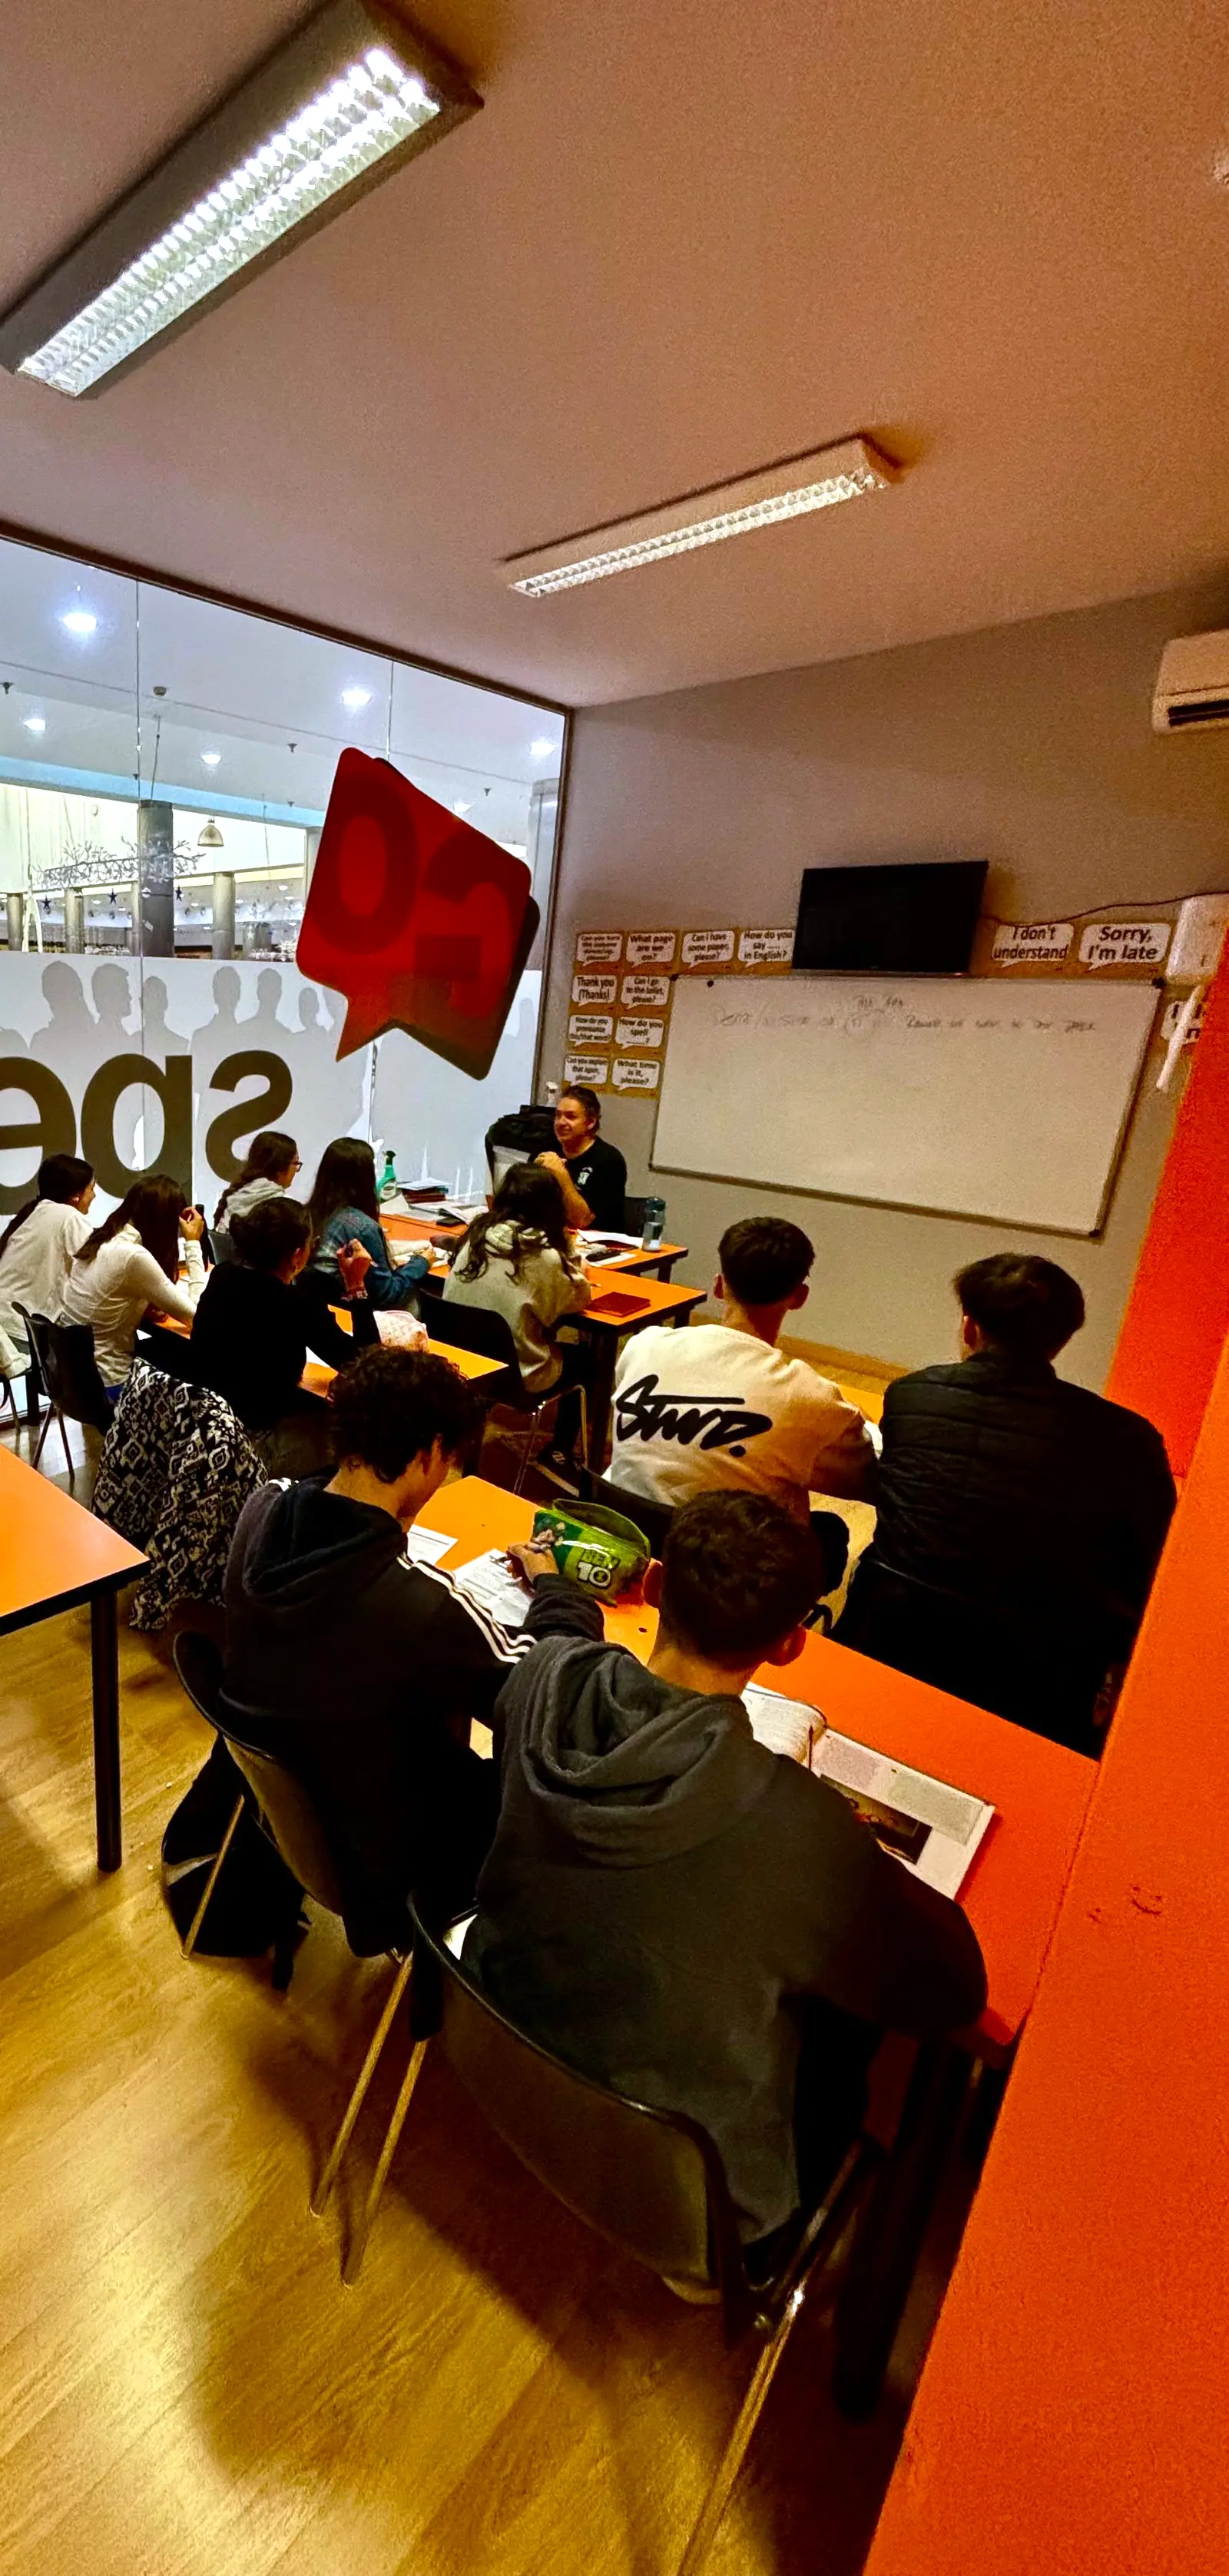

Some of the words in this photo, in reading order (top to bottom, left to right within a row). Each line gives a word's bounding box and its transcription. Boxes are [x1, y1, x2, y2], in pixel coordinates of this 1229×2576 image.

[653, 935, 673, 944] page
[776, 932, 793, 940] you
[1021, 926, 1056, 940] don't
[1098, 927, 1152, 943] Sorry,
[752, 942, 766, 950] say
[993, 944, 1069, 960] understand
[1088, 945, 1116, 960] I'm
[1121, 946, 1158, 960] late
[577, 976, 599, 986] Thank
[600, 979, 614, 989] you
[617, 1059, 638, 1068] What
[578, 1562, 611, 1587] 10
